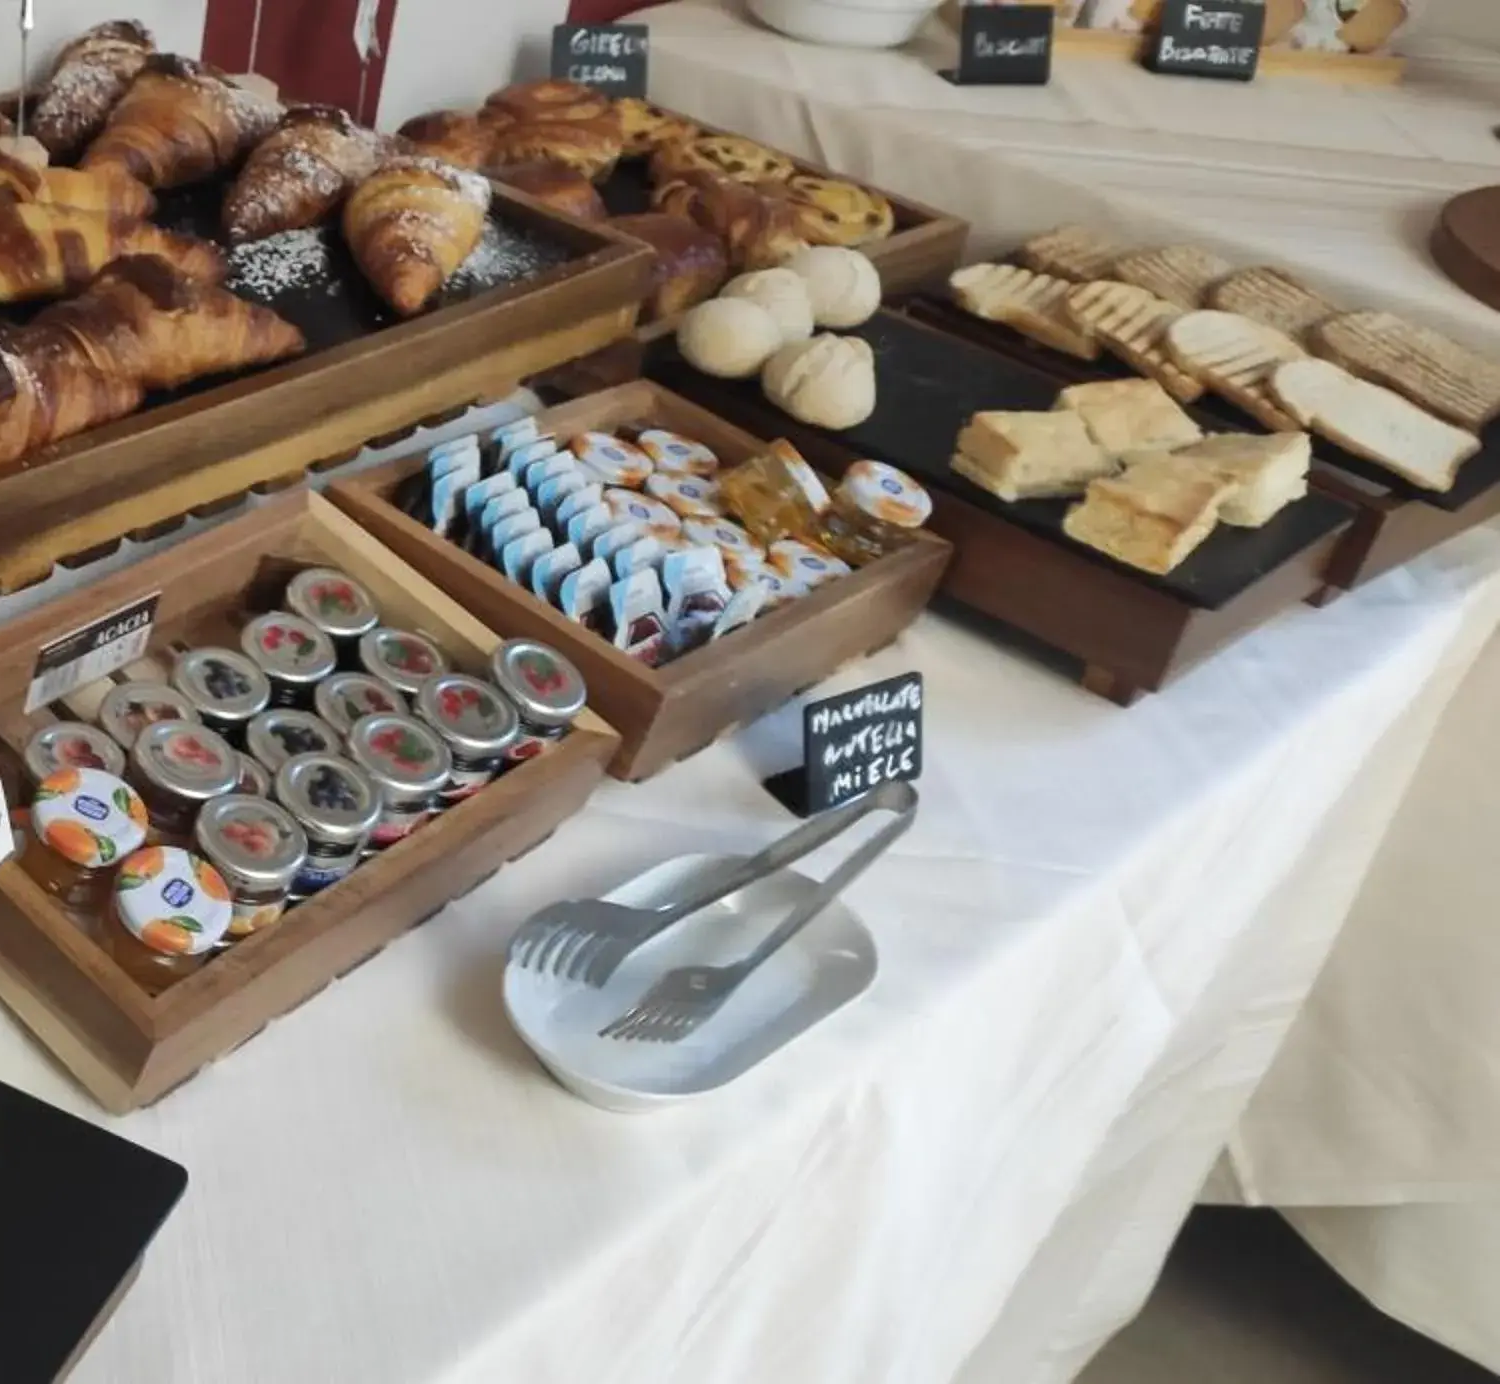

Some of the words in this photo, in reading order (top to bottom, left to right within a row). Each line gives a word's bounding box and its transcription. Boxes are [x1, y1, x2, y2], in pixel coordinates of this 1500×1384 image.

[93, 609, 150, 648] ACACIA
[823, 720, 917, 768] NUTELLA
[832, 745, 915, 797] MIELE
